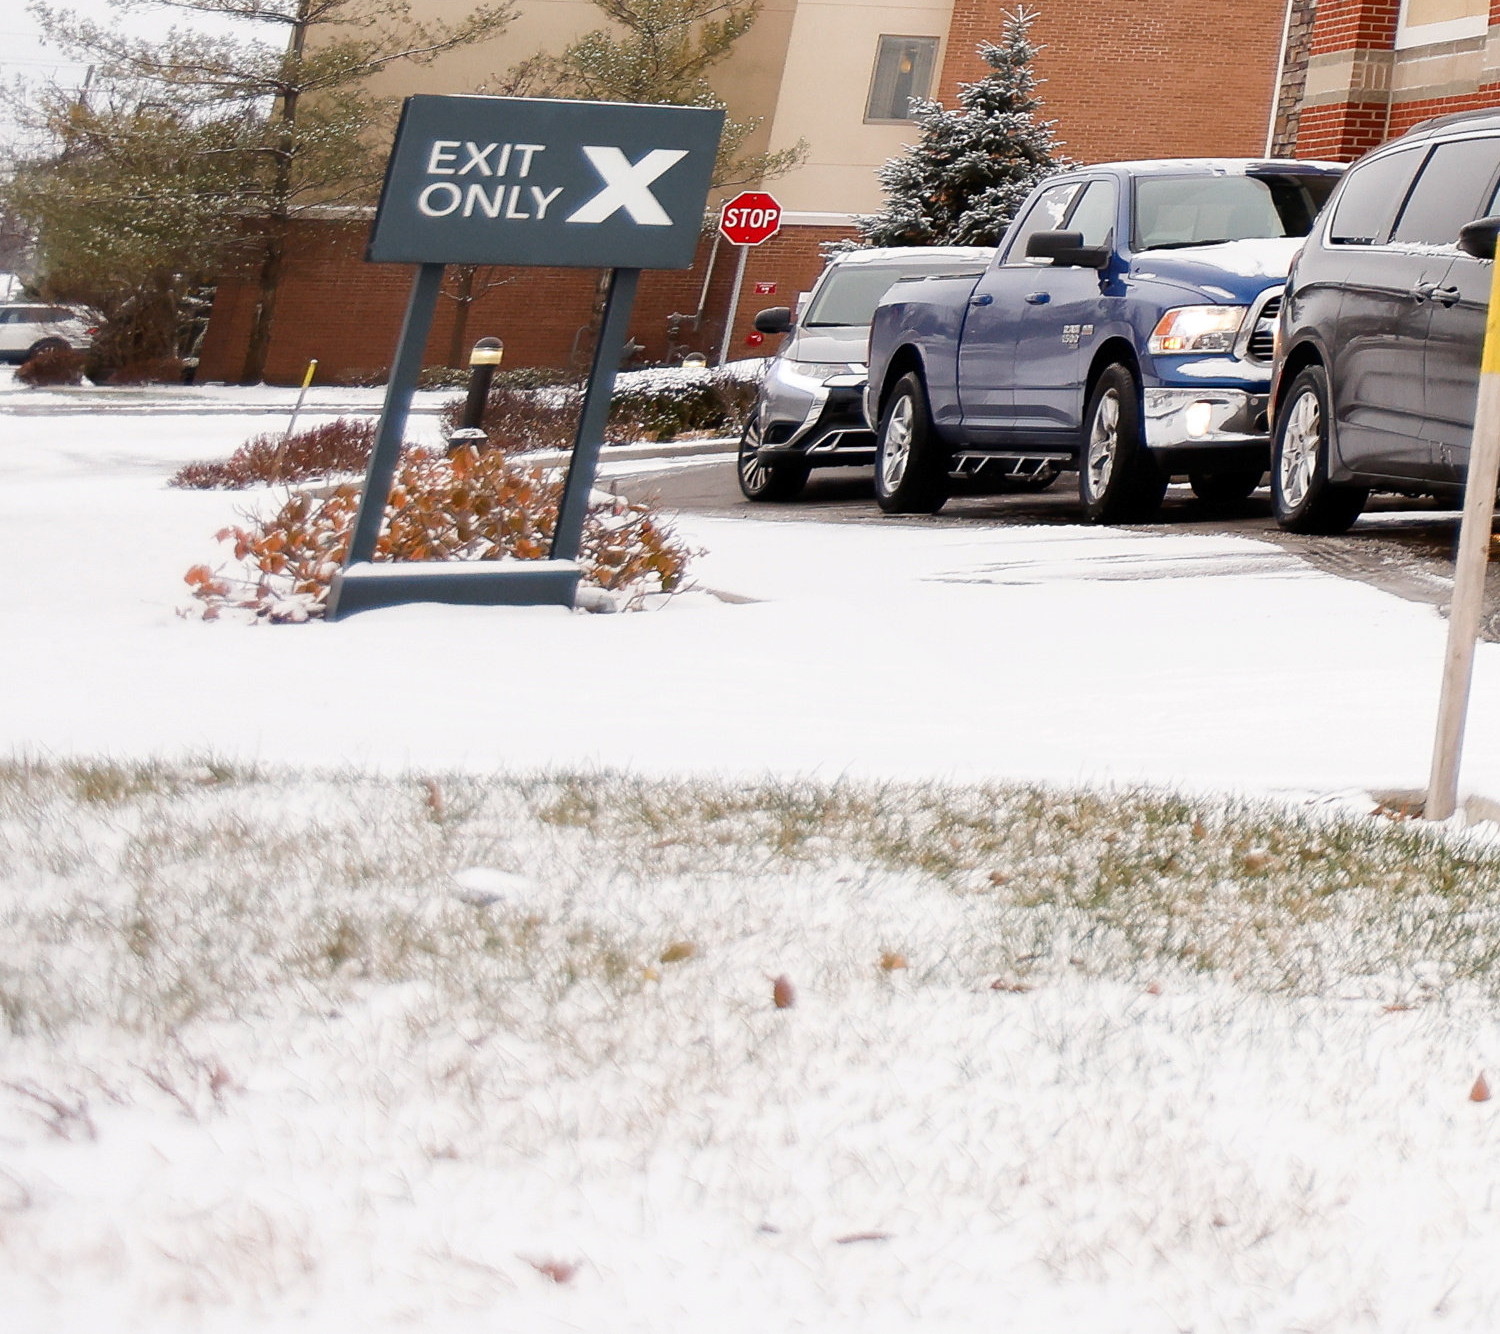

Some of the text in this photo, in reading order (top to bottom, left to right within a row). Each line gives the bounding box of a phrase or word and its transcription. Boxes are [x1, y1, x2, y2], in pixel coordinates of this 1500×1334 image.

[426, 140, 547, 179] EXIT
[417, 181, 565, 220] ONLY
[724, 207, 778, 229] STOP
